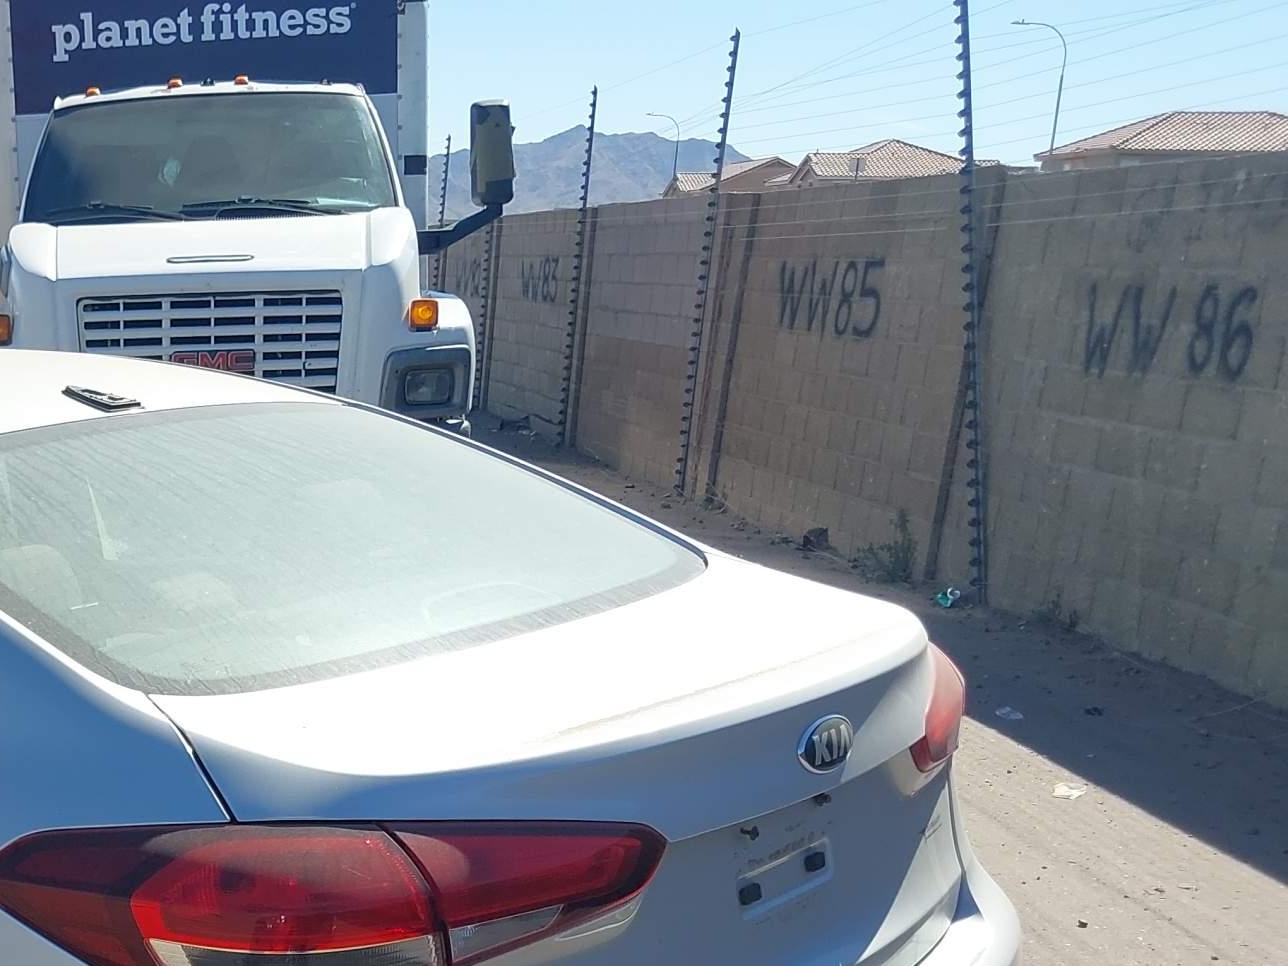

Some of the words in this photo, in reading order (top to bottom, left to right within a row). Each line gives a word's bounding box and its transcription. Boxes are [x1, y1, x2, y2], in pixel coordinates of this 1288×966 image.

[52, 8, 193, 62] planet
[201, 3, 352, 41] fitness
[520, 256, 560, 303] WW83
[779, 256, 885, 339] WW85
[173, 351, 254, 370] GMC
[812, 724, 852, 765] KIA
